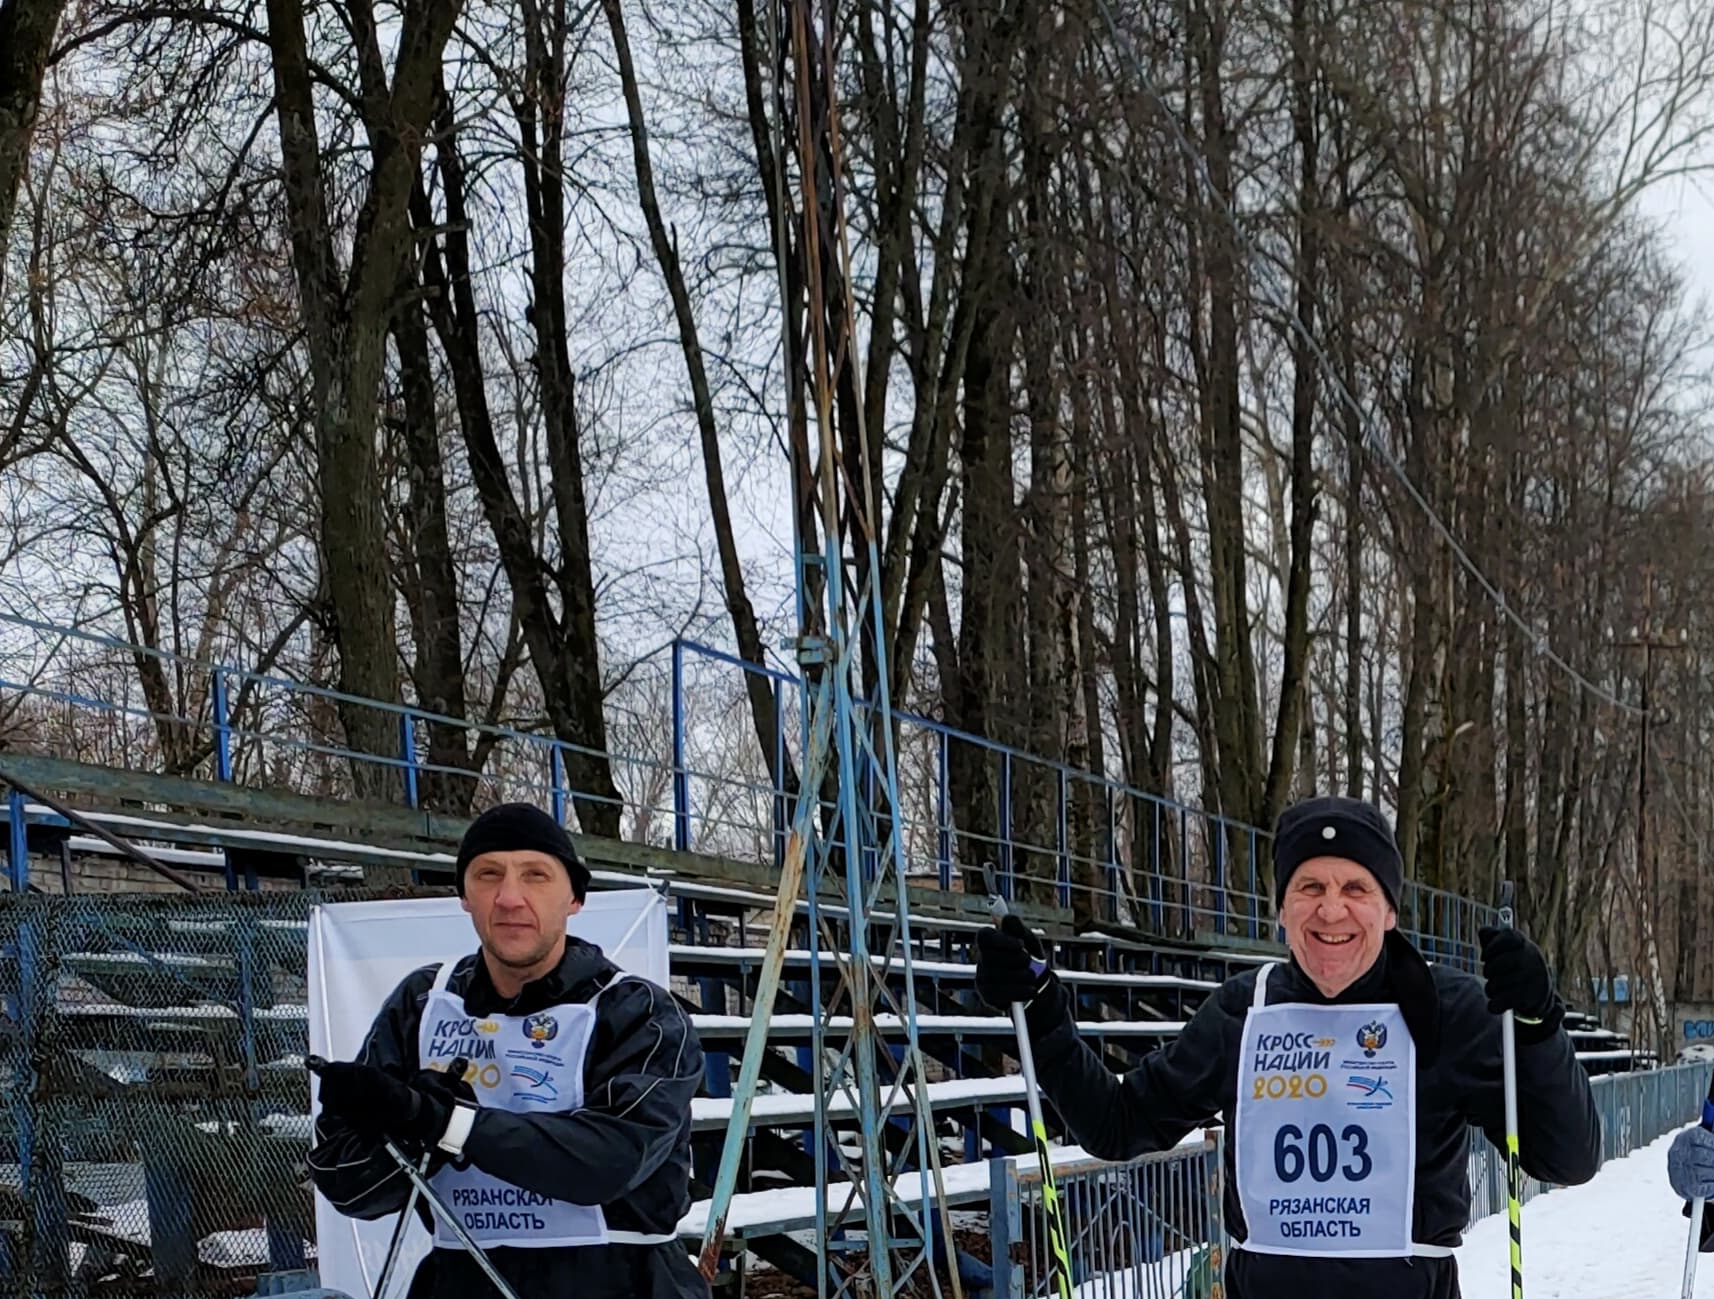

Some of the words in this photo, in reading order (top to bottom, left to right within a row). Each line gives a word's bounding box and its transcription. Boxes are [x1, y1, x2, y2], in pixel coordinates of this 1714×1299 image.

[1257, 1032, 1315, 1051] КРОСС
[1254, 1051, 1331, 1072] НАЦИИ
[1253, 1074, 1328, 1099] 2020
[1274, 1123, 1372, 1183] 603
[1269, 1197, 1370, 1216] РЯЗАНСКАЯ
[464, 1211, 545, 1230] ОБЛАСТЬ
[1280, 1220, 1361, 1238] ОБЛАСТЬ
